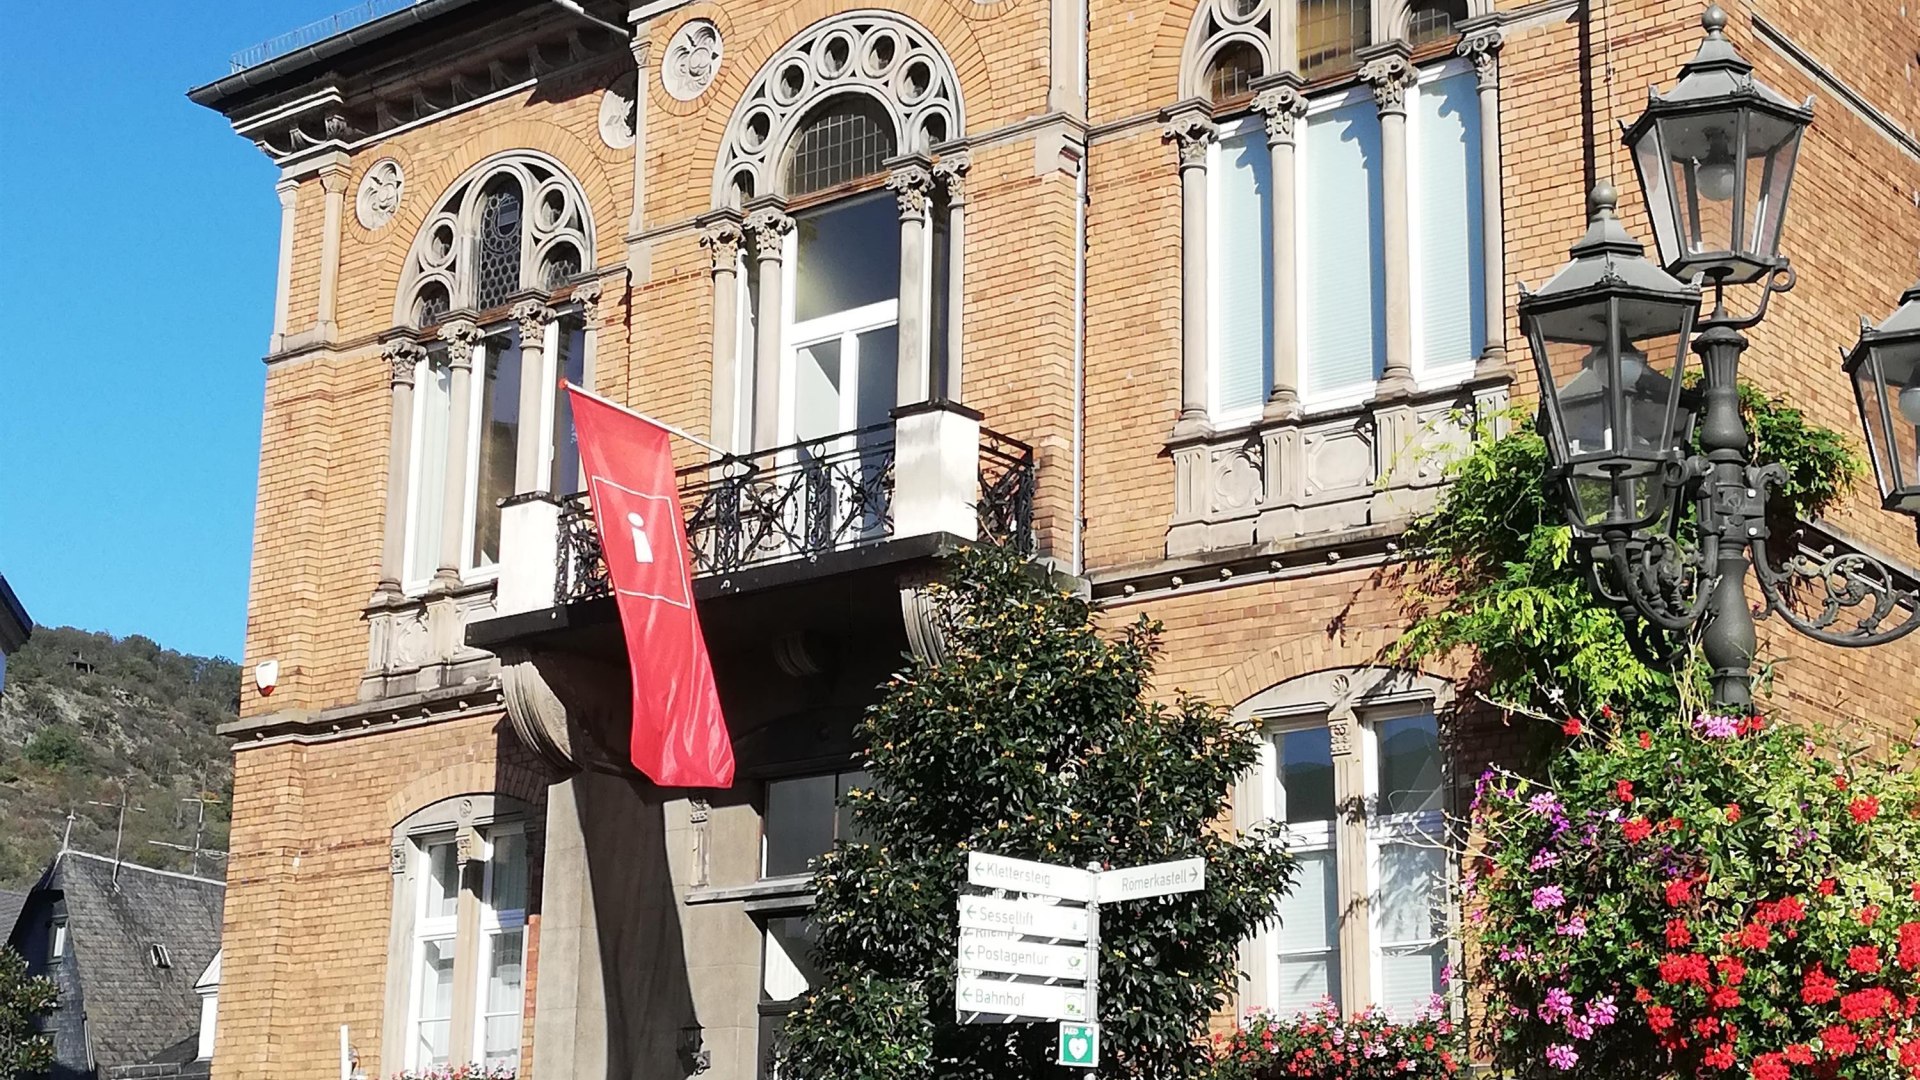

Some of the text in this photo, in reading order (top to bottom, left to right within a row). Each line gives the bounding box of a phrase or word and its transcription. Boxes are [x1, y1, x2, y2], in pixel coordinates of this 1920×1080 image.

[986, 862, 1051, 889] Klettersteig
[979, 906, 1034, 926] Sessellift
[977, 945, 1049, 966] Postagentur
[975, 988, 1025, 1007] Bahnhof
